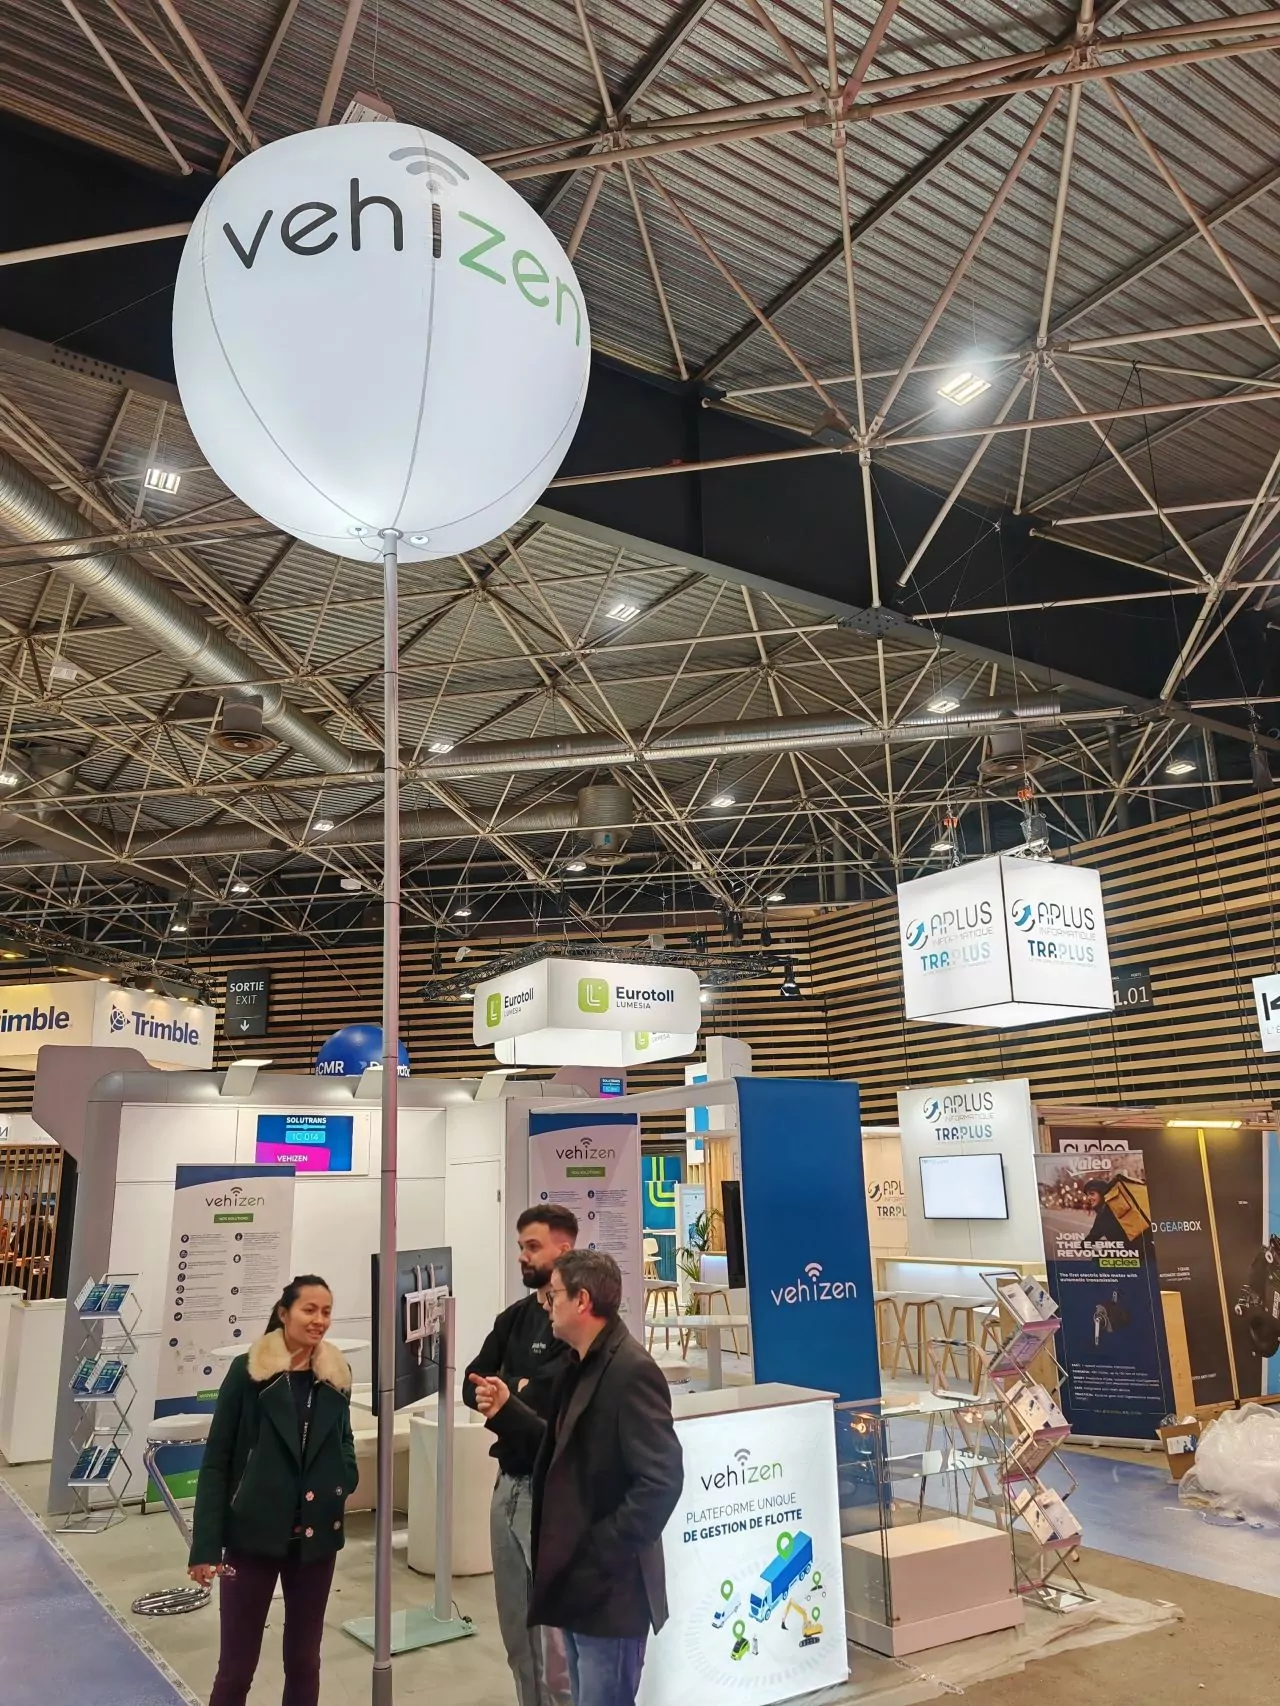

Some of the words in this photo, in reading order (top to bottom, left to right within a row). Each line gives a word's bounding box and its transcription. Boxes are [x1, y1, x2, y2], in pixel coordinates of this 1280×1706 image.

[223, 177, 582, 347] vehizen
[930, 901, 992, 937] APLUS
[1037, 902, 1095, 930] APLUS
[920, 941, 991, 971] TRAPLUS
[1027, 939, 1094, 962] TRAPLUS
[229, 980, 265, 993] SORTIE
[615, 986, 674, 1003] Eurotoll
[235, 994, 259, 1006] EXIT
[504, 987, 534, 1009] Eurotoll
[616, 1001, 651, 1010] LUMESIA
[0, 1006, 70, 1032] imble
[132, 1011, 200, 1046] Trimble
[943, 1091, 993, 1114] APLUS
[286, 1116, 327, 1124] SOLUTRANS
[935, 1124, 992, 1141] TRAPLUS
[276, 1154, 308, 1162] VEHIZEN
[555, 1145, 616, 1160] vehizen
[1069, 1156, 1112, 1170] Valeo
[205, 1194, 265, 1207] vehizen
[1159, 1221, 1202, 1232] GEARBOX
[1055, 1233, 1086, 1241] JOIN
[1056, 1241, 1082, 1249] THE
[1083, 1241, 1125, 1249] E-BIKE
[1057, 1249, 1140, 1258] REVOLUTION
[1101, 1259, 1138, 1267] cyclee
[771, 1275, 858, 1307] vehizen
[701, 1461, 783, 1491] vehizen
[686, 1500, 756, 1524] PLATEFORME
[757, 1492, 797, 1509] UNIQUE
[683, 1530, 698, 1543] DE
[700, 1519, 747, 1539] GESTION
[749, 1516, 763, 1530] DE
[765, 1508, 803, 1526] FLOTTE
